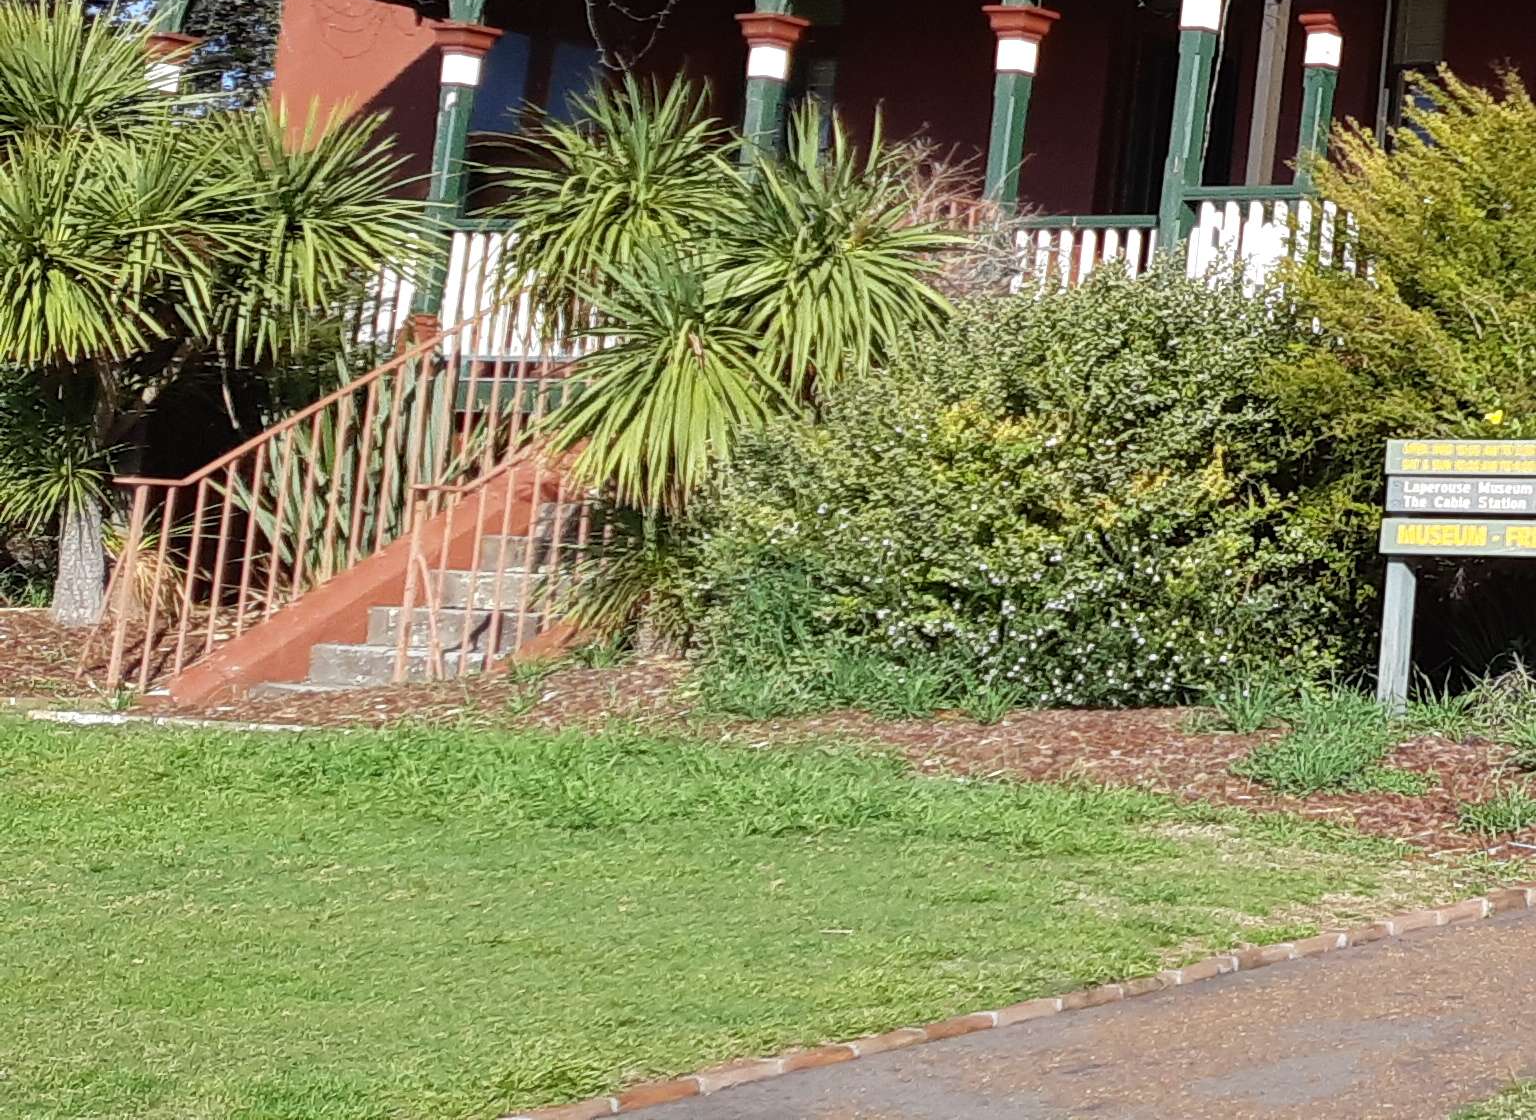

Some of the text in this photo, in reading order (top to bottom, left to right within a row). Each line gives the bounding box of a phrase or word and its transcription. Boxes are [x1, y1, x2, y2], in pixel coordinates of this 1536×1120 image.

[1478, 482, 1533, 495] Museum
[1403, 495, 1430, 509] The
[1434, 496, 1471, 510] Cable
[1478, 496, 1527, 510] Station
[1397, 524, 1488, 546] MUSEUM
